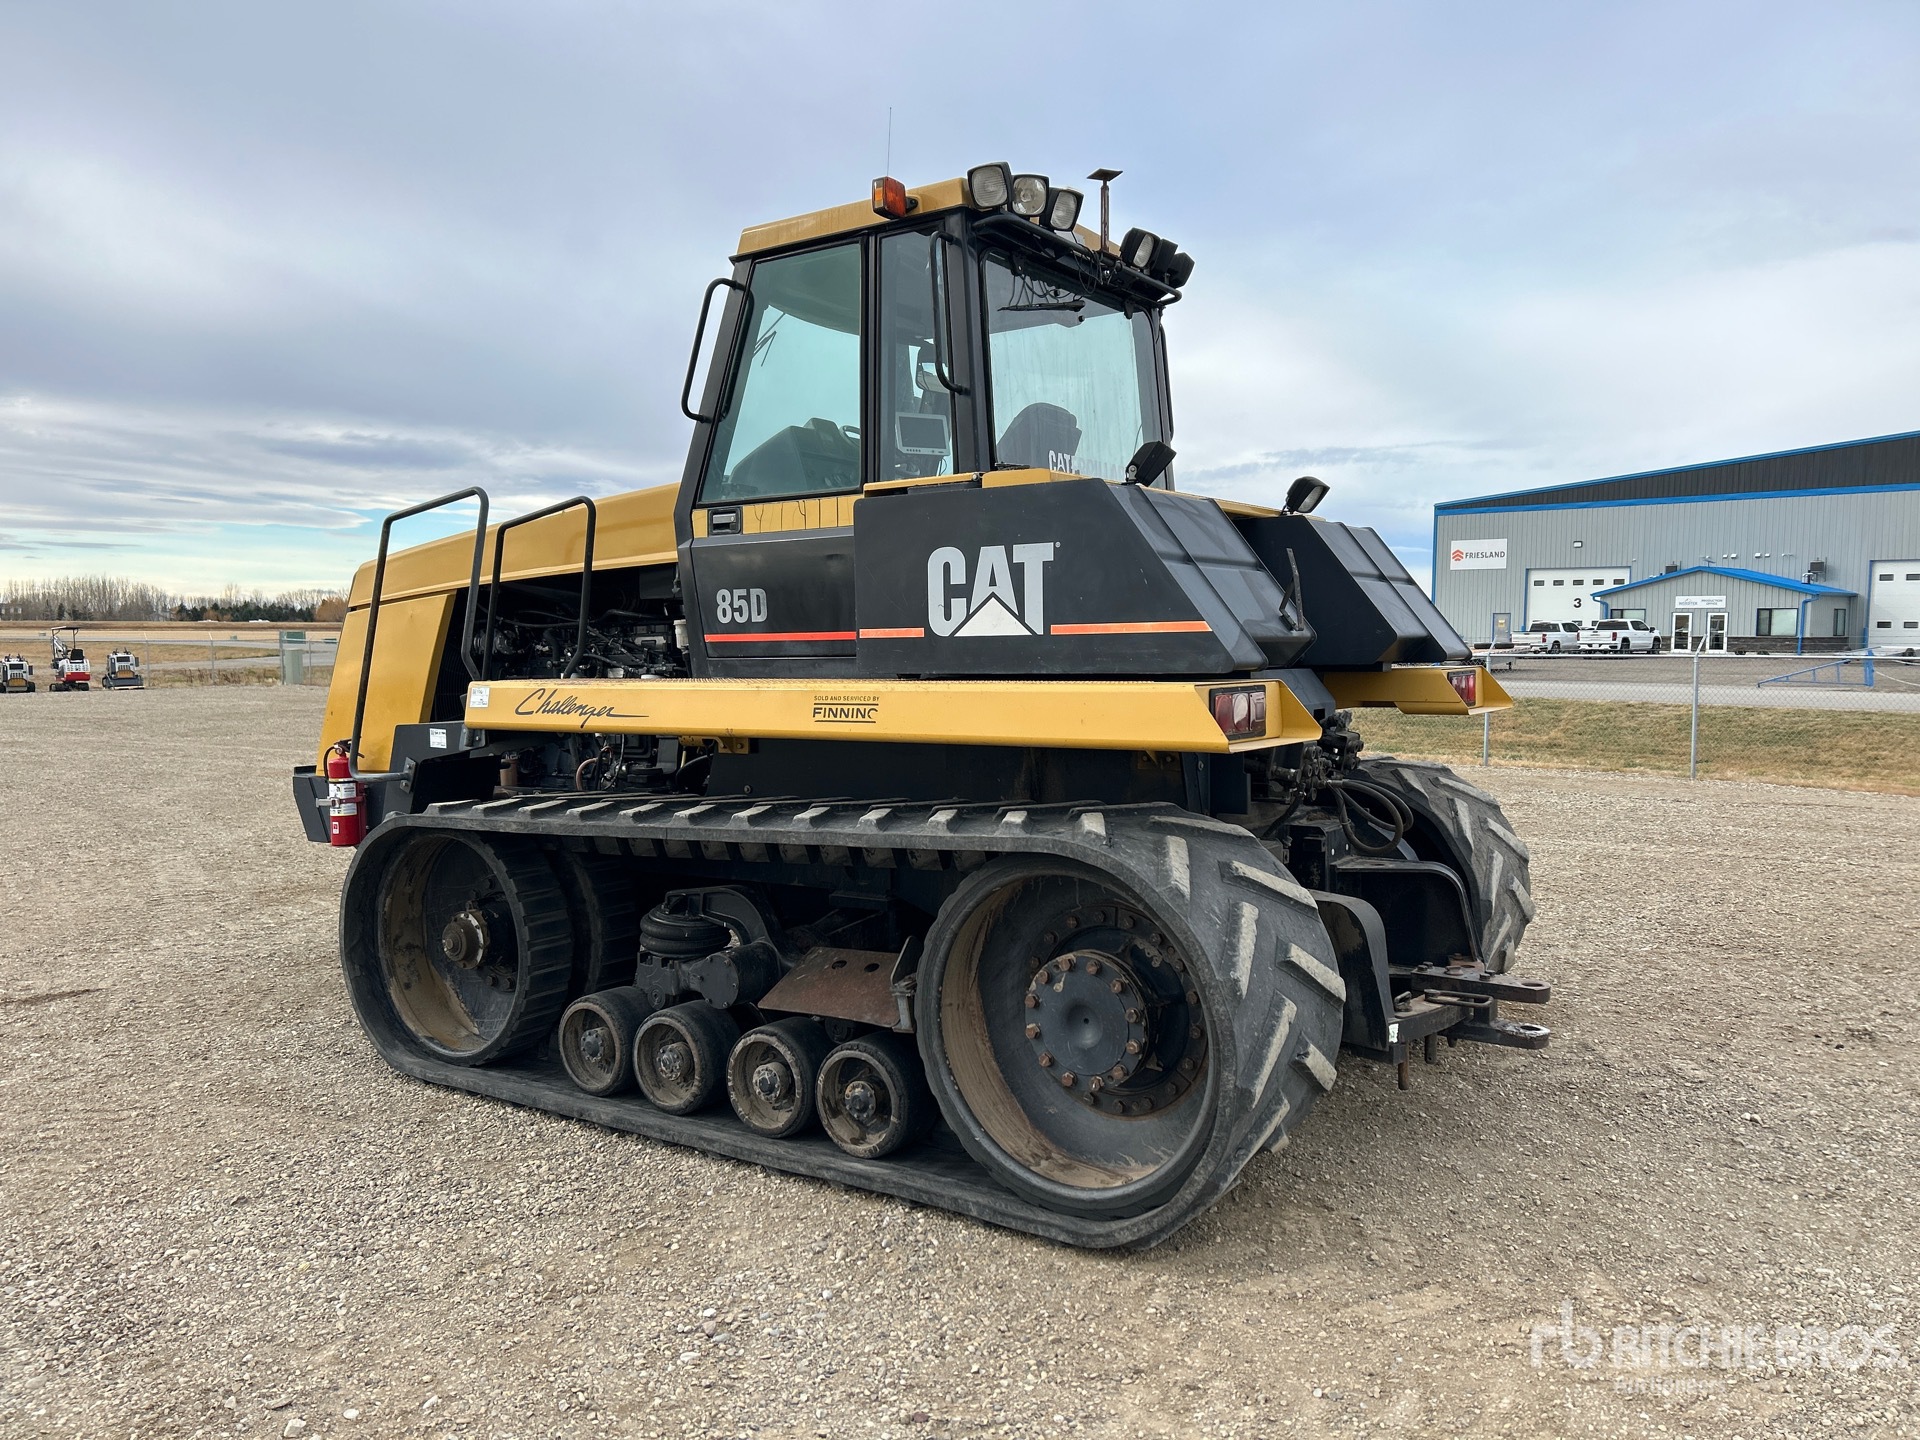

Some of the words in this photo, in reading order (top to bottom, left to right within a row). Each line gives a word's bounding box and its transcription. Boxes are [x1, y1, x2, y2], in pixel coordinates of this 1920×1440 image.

[1465, 551, 1506, 559] FRIESLAND
[716, 588, 768, 624] 85D
[927, 542, 1054, 637] CAT
[1573, 597, 1582, 609] 3
[514, 688, 650, 729] Challenger
